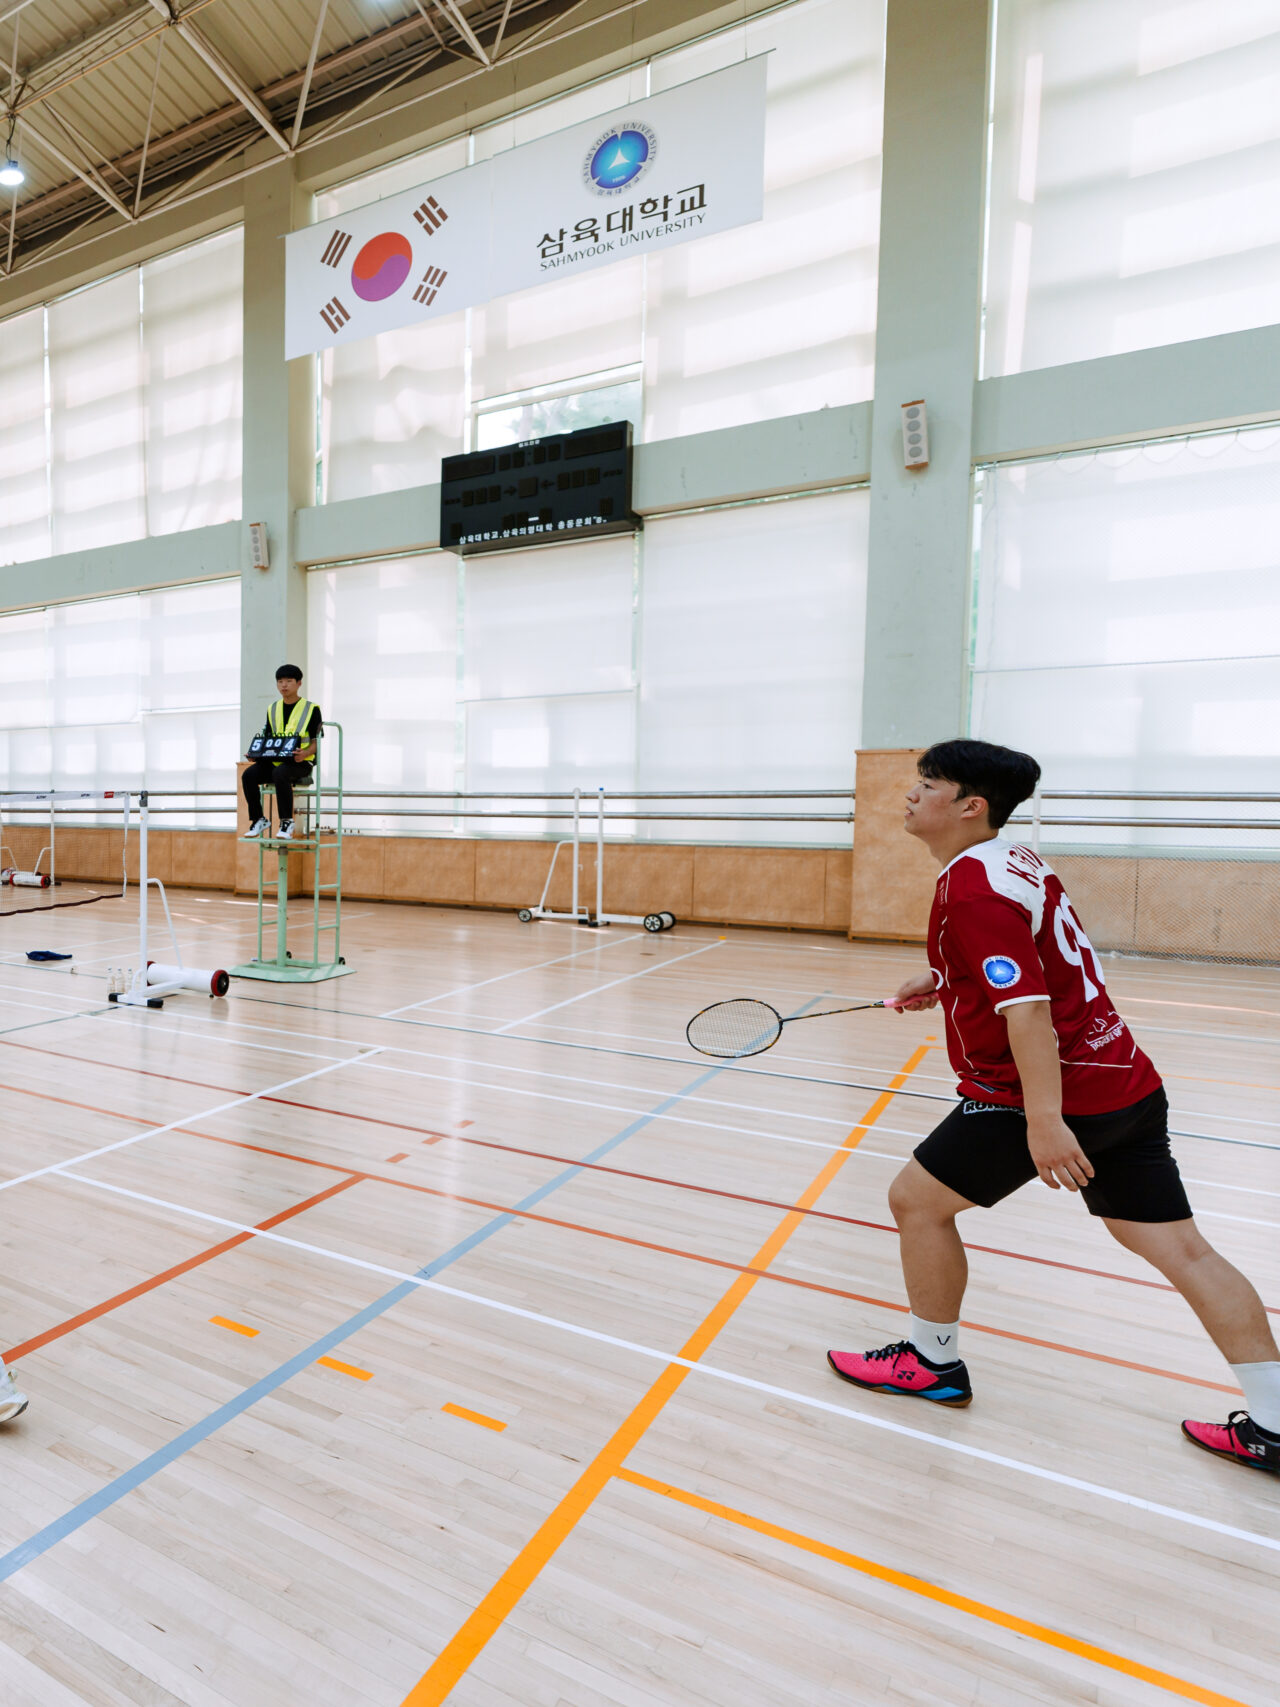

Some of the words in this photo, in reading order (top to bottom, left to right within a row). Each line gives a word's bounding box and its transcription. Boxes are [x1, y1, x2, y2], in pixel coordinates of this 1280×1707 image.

[536, 183, 707, 259] 삼육대학교
[540, 240, 615, 272] SAHMYOOK
[620, 212, 706, 247] UNIVERSITY
[252, 739, 262, 750] 5
[285, 739, 295, 750] 4
